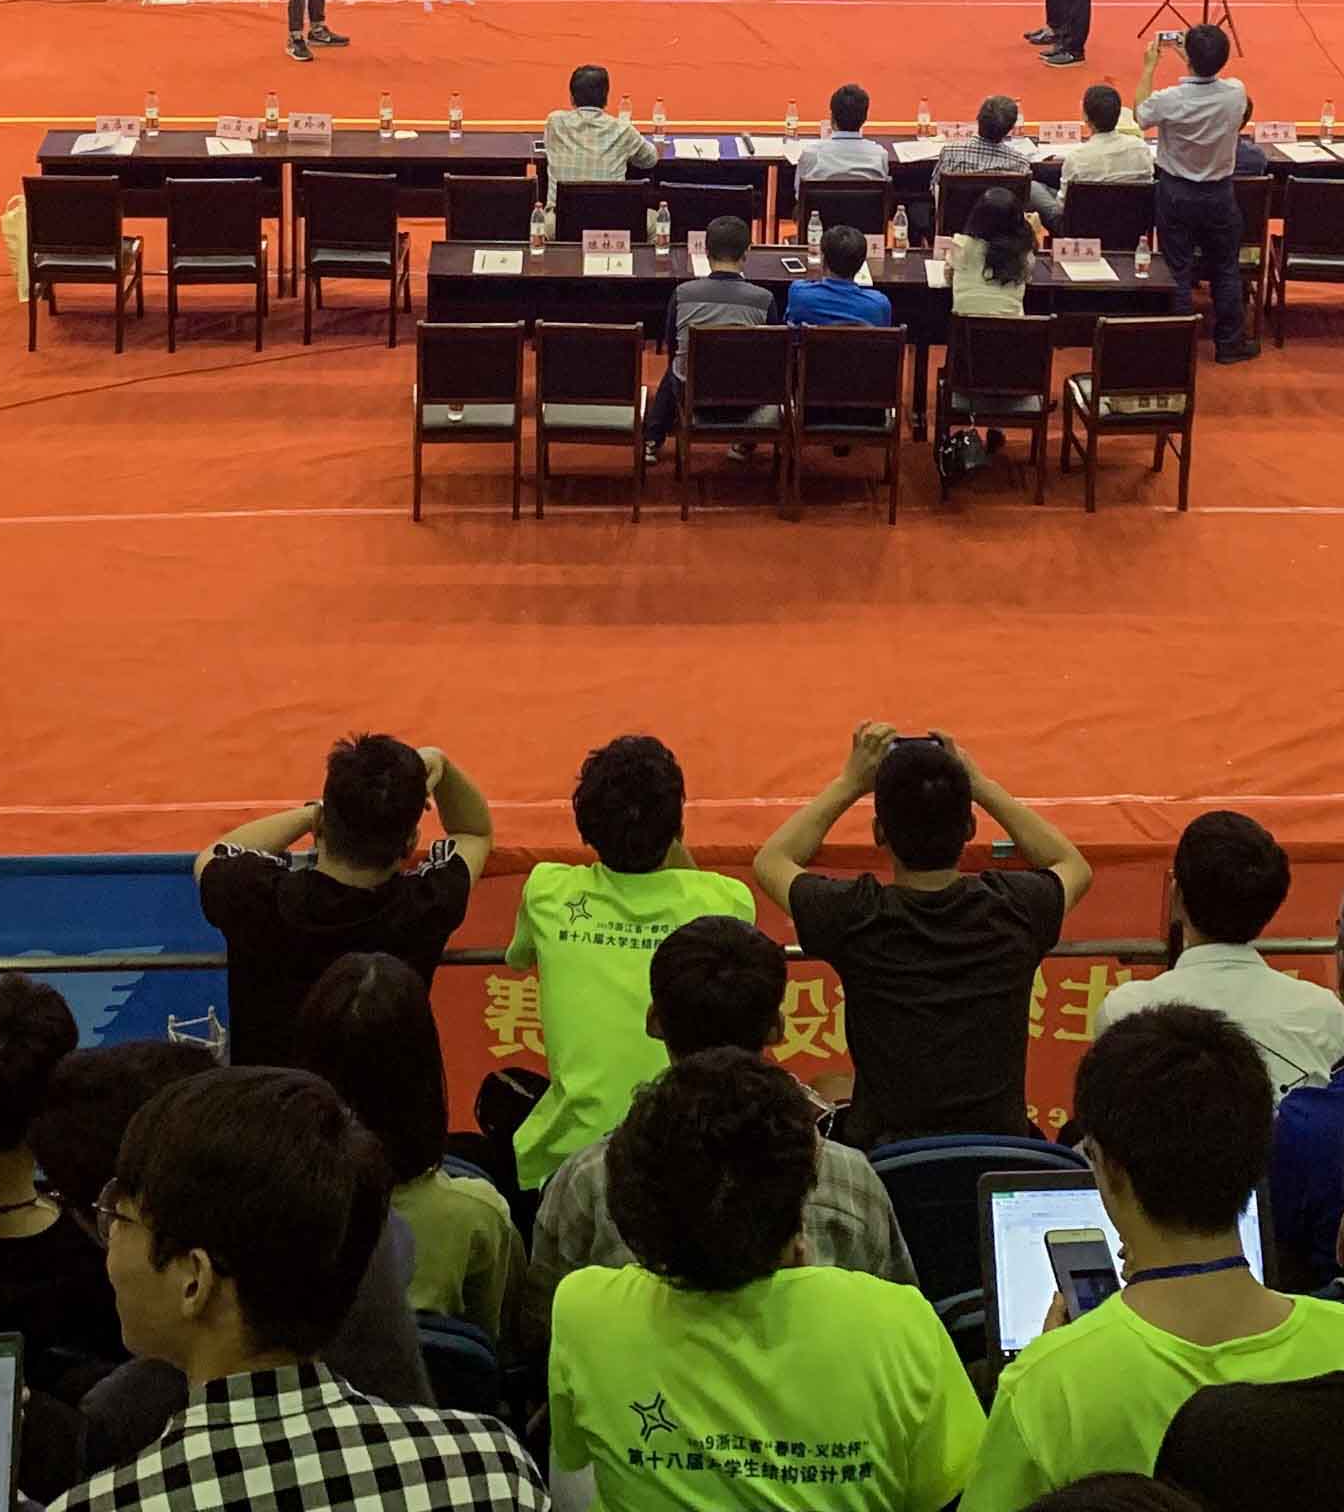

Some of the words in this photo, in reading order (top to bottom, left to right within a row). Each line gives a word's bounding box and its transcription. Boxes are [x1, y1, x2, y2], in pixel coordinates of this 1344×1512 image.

[627, 1447, 874, 1484] 第十八届大学生结构设计竞赛
